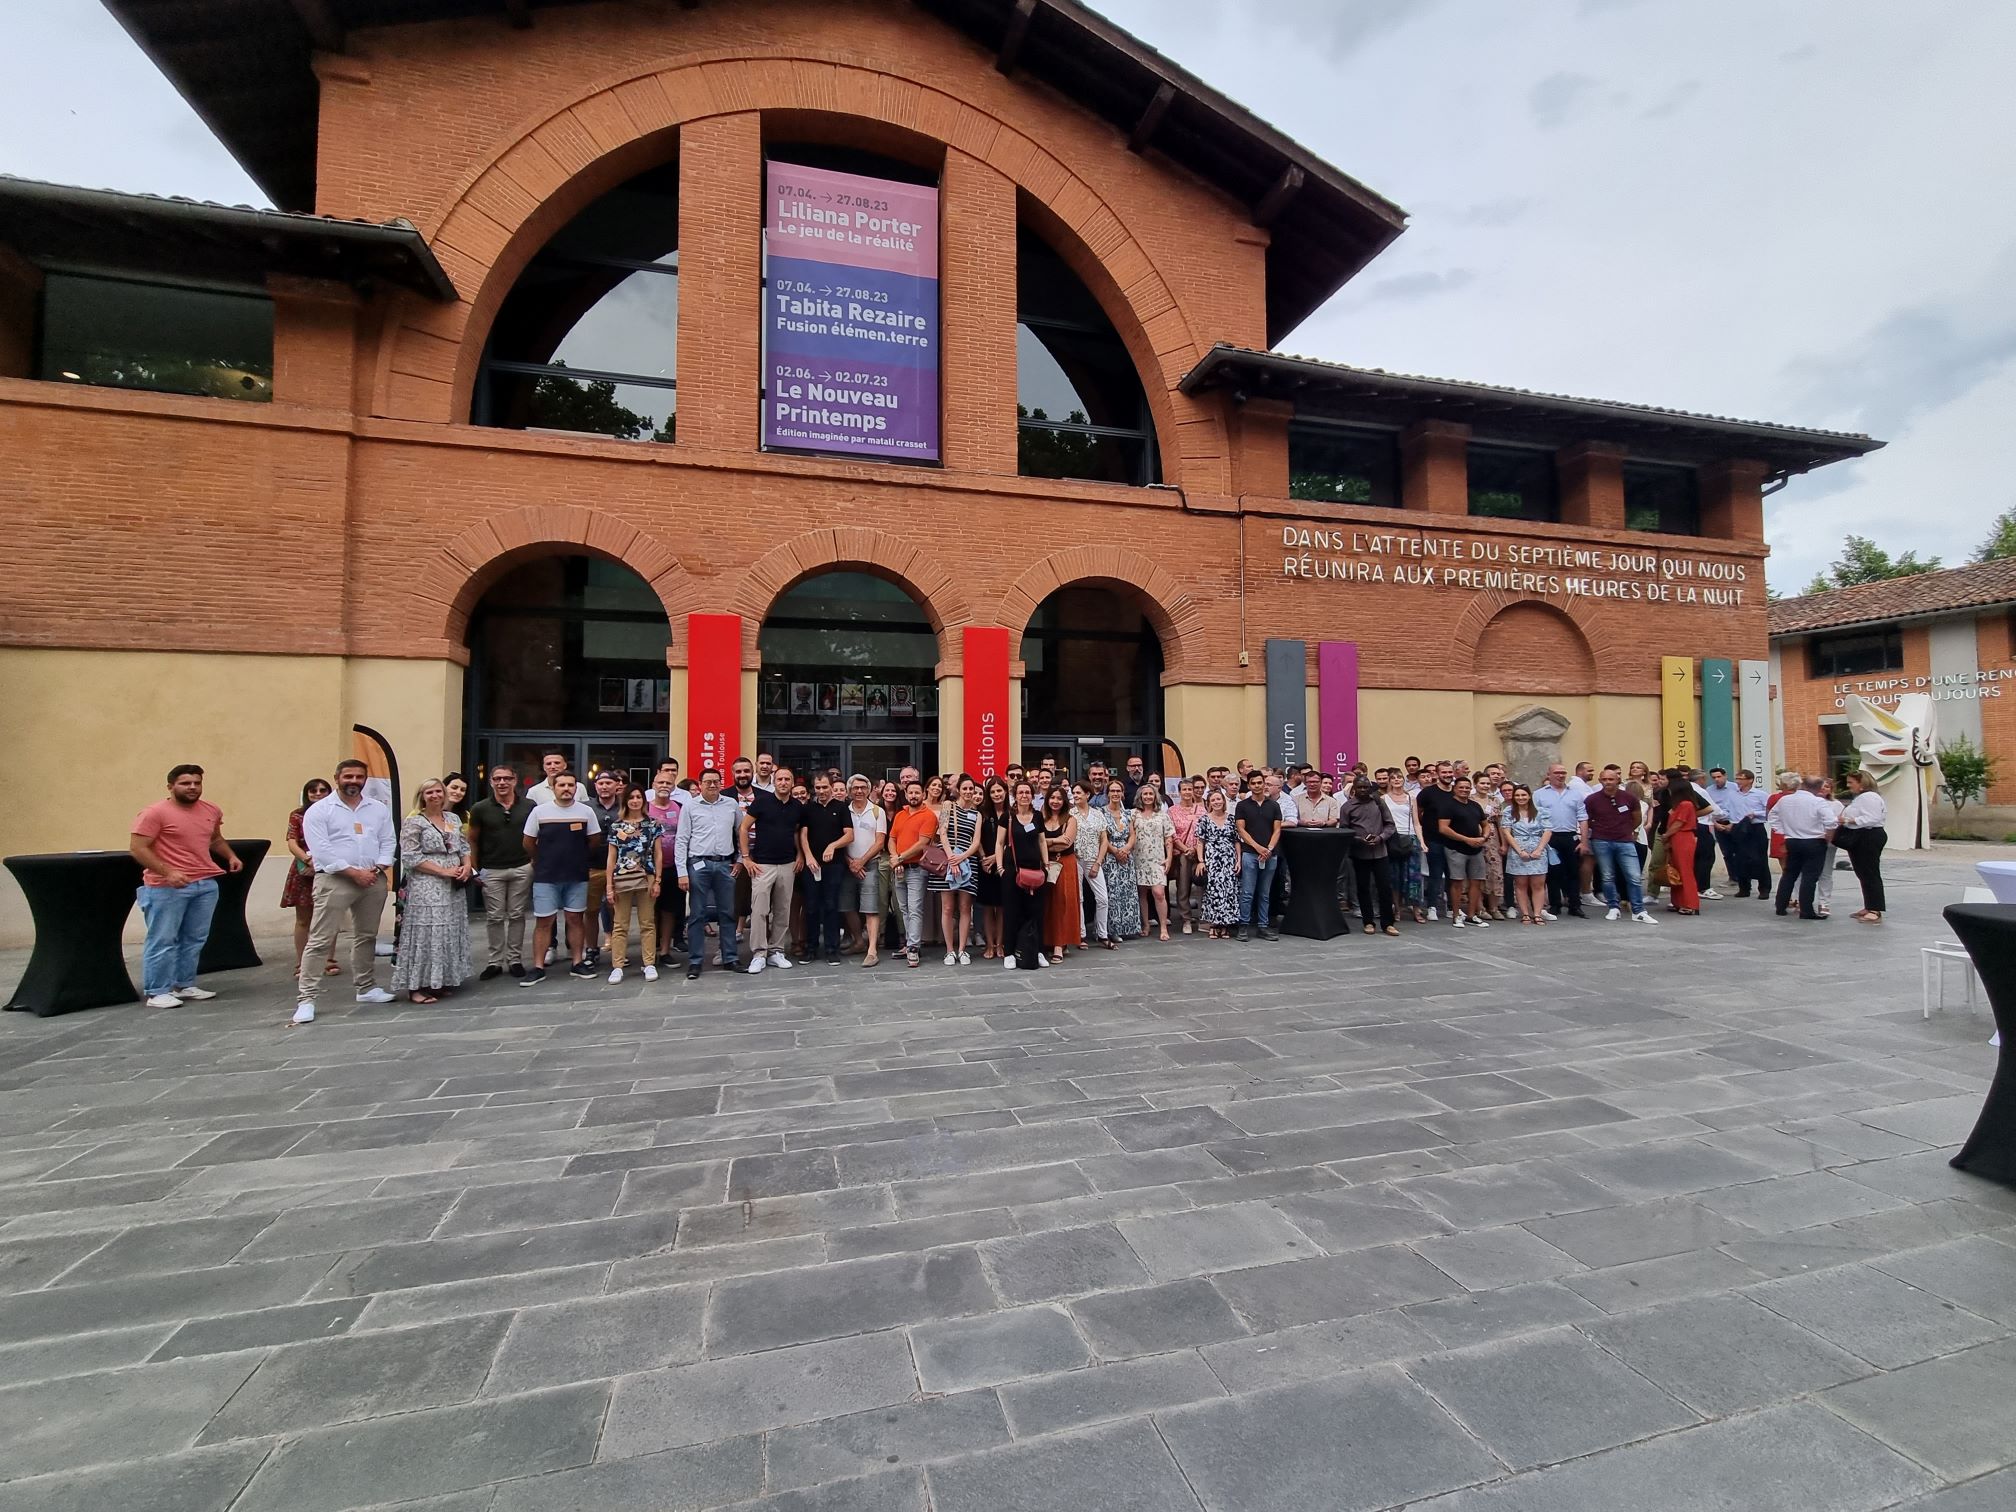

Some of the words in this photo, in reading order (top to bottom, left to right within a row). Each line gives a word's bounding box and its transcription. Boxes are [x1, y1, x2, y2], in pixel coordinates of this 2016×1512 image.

[777, 185, 816, 200] 07.04.
[836, 194, 888, 211] 27.08.23
[778, 199, 849, 227] Liliana
[855, 211, 922, 237] Porter
[778, 221, 797, 233] Le
[799, 223, 823, 238] jeu
[826, 228, 845, 242] de
[848, 230, 862, 245] la
[865, 234, 914, 252] réalité
[776, 280, 816, 294] 07.04.
[835, 286, 889, 303] 27.08.23
[776, 294, 843, 319] Tabita
[848, 302, 926, 330] Rezaire
[777, 317, 827, 335] Fusion
[831, 321, 928, 348] élémen.terre
[776, 365, 815, 380] 02.06.
[835, 372, 888, 387] 02.07.23
[776, 379, 802, 399] Le
[808, 383, 898, 409] Nouveau
[776, 403, 887, 433] Printemps
[776, 425, 808, 439] Édition
[809, 431, 850, 443] imaginée
[851, 435, 866, 444] par
[896, 440, 927, 450] crasset
[1283, 526, 1344, 550] DANS
[1353, 532, 1464, 559] L'ATTENTE
[1471, 541, 1499, 561] DU
[1508, 544, 1603, 569] SEPTIÈME
[1608, 553, 1657, 574] JOUR
[1662, 558, 1693, 580] QUI
[1698, 562, 1746, 581] NOUS
[1284, 552, 1385, 583] RÉUNIRA
[1393, 565, 1435, 585] AUX
[1443, 567, 1559, 594] PREMIÈRES
[1566, 577, 1641, 600] HEURES
[1648, 583, 1671, 601] DE
[1677, 586, 1697, 603] LA
[1703, 588, 1744, 606] NUIT
[1834, 683, 1850, 694] LE
[1856, 678, 1909, 692] TEMPS
[1915, 673, 1968, 687] D'UNE
[1976, 669, 2016, 681] REN
[717, 732, 726, 767] Toulouse
